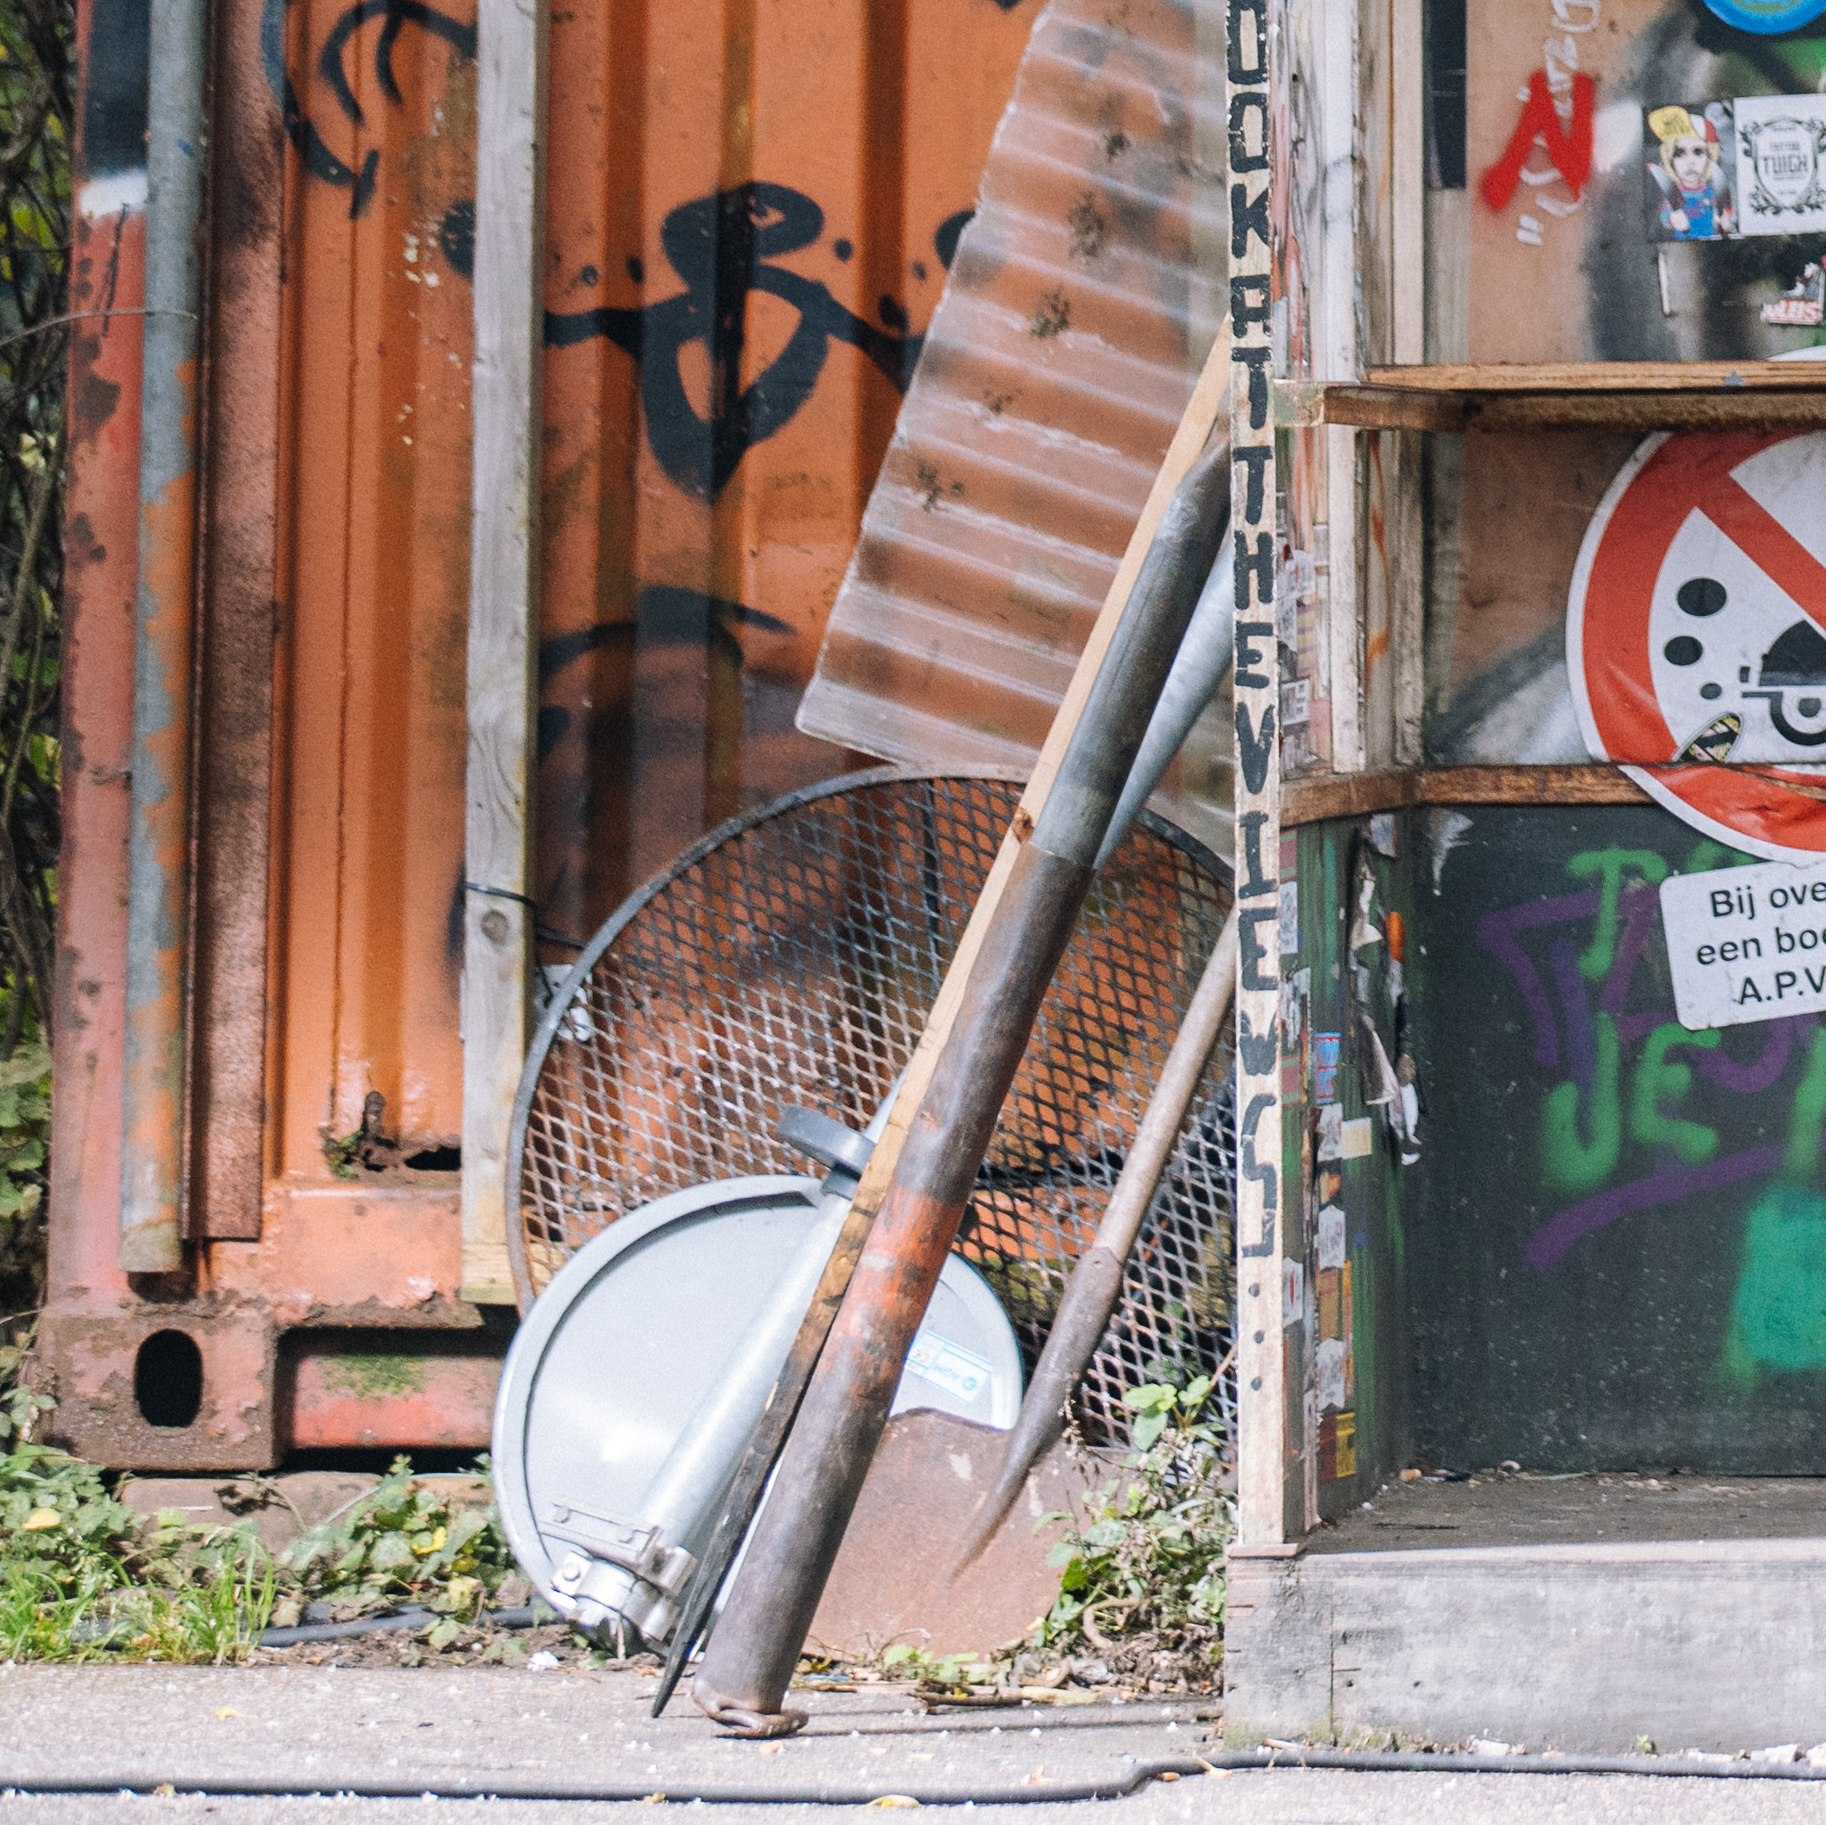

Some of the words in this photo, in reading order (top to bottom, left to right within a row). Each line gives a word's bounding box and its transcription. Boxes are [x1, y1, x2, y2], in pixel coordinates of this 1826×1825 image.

[1708, 882, 1757, 921] Bij
[1696, 934, 1763, 967] een
[1539, 1011, 1719, 1188] JE
